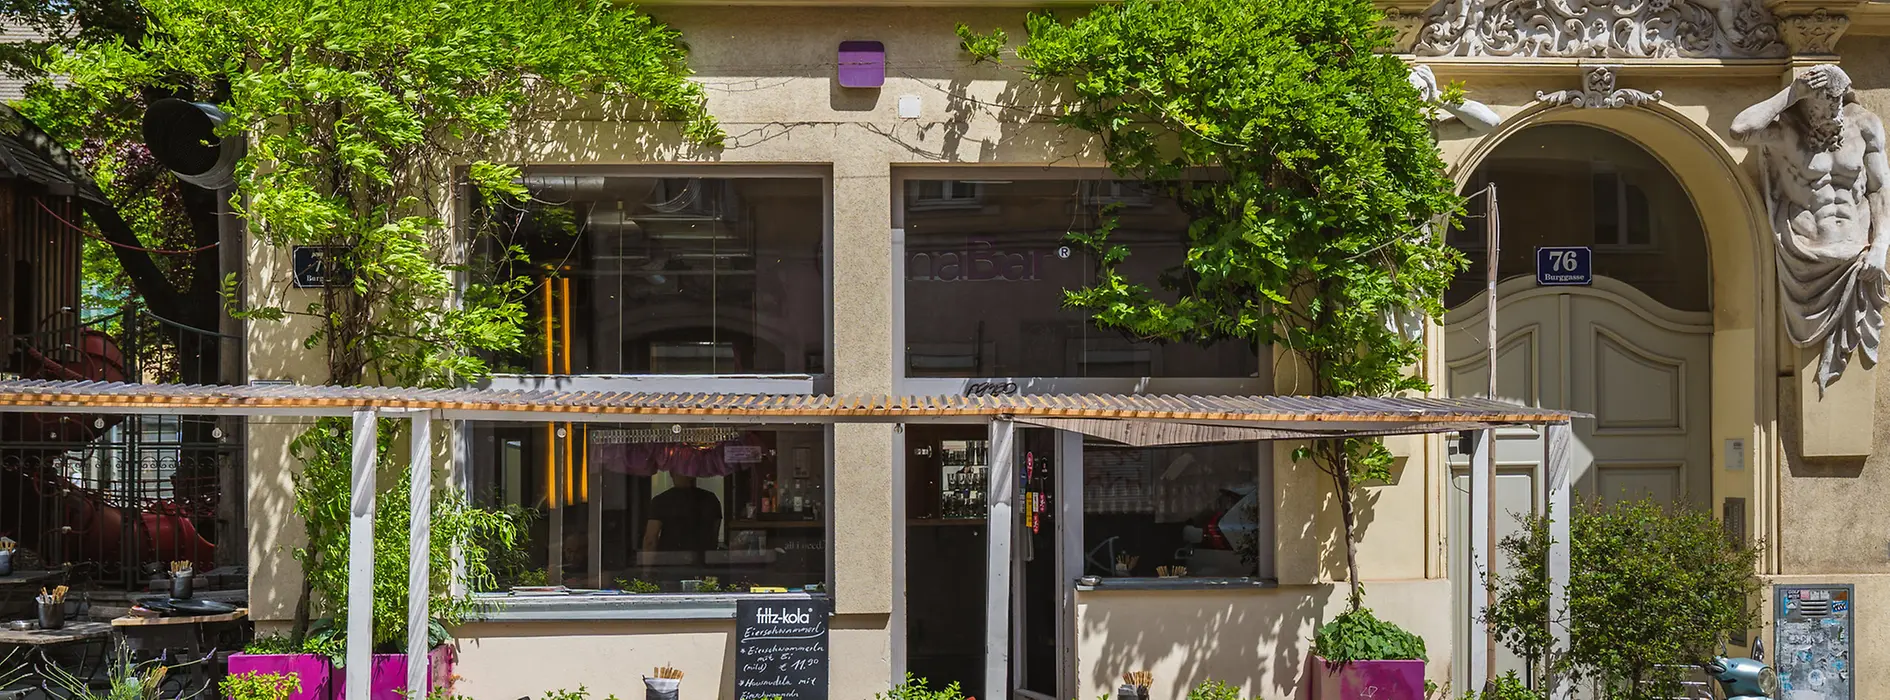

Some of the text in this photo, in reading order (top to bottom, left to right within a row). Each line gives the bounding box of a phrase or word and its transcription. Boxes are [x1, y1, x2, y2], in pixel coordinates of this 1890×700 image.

[1549, 250, 1578, 272] 76
[1544, 273, 1585, 282] Burggasse
[757, 652, 794, 662] mit Ei
[798, 677, 817, 686] mit
